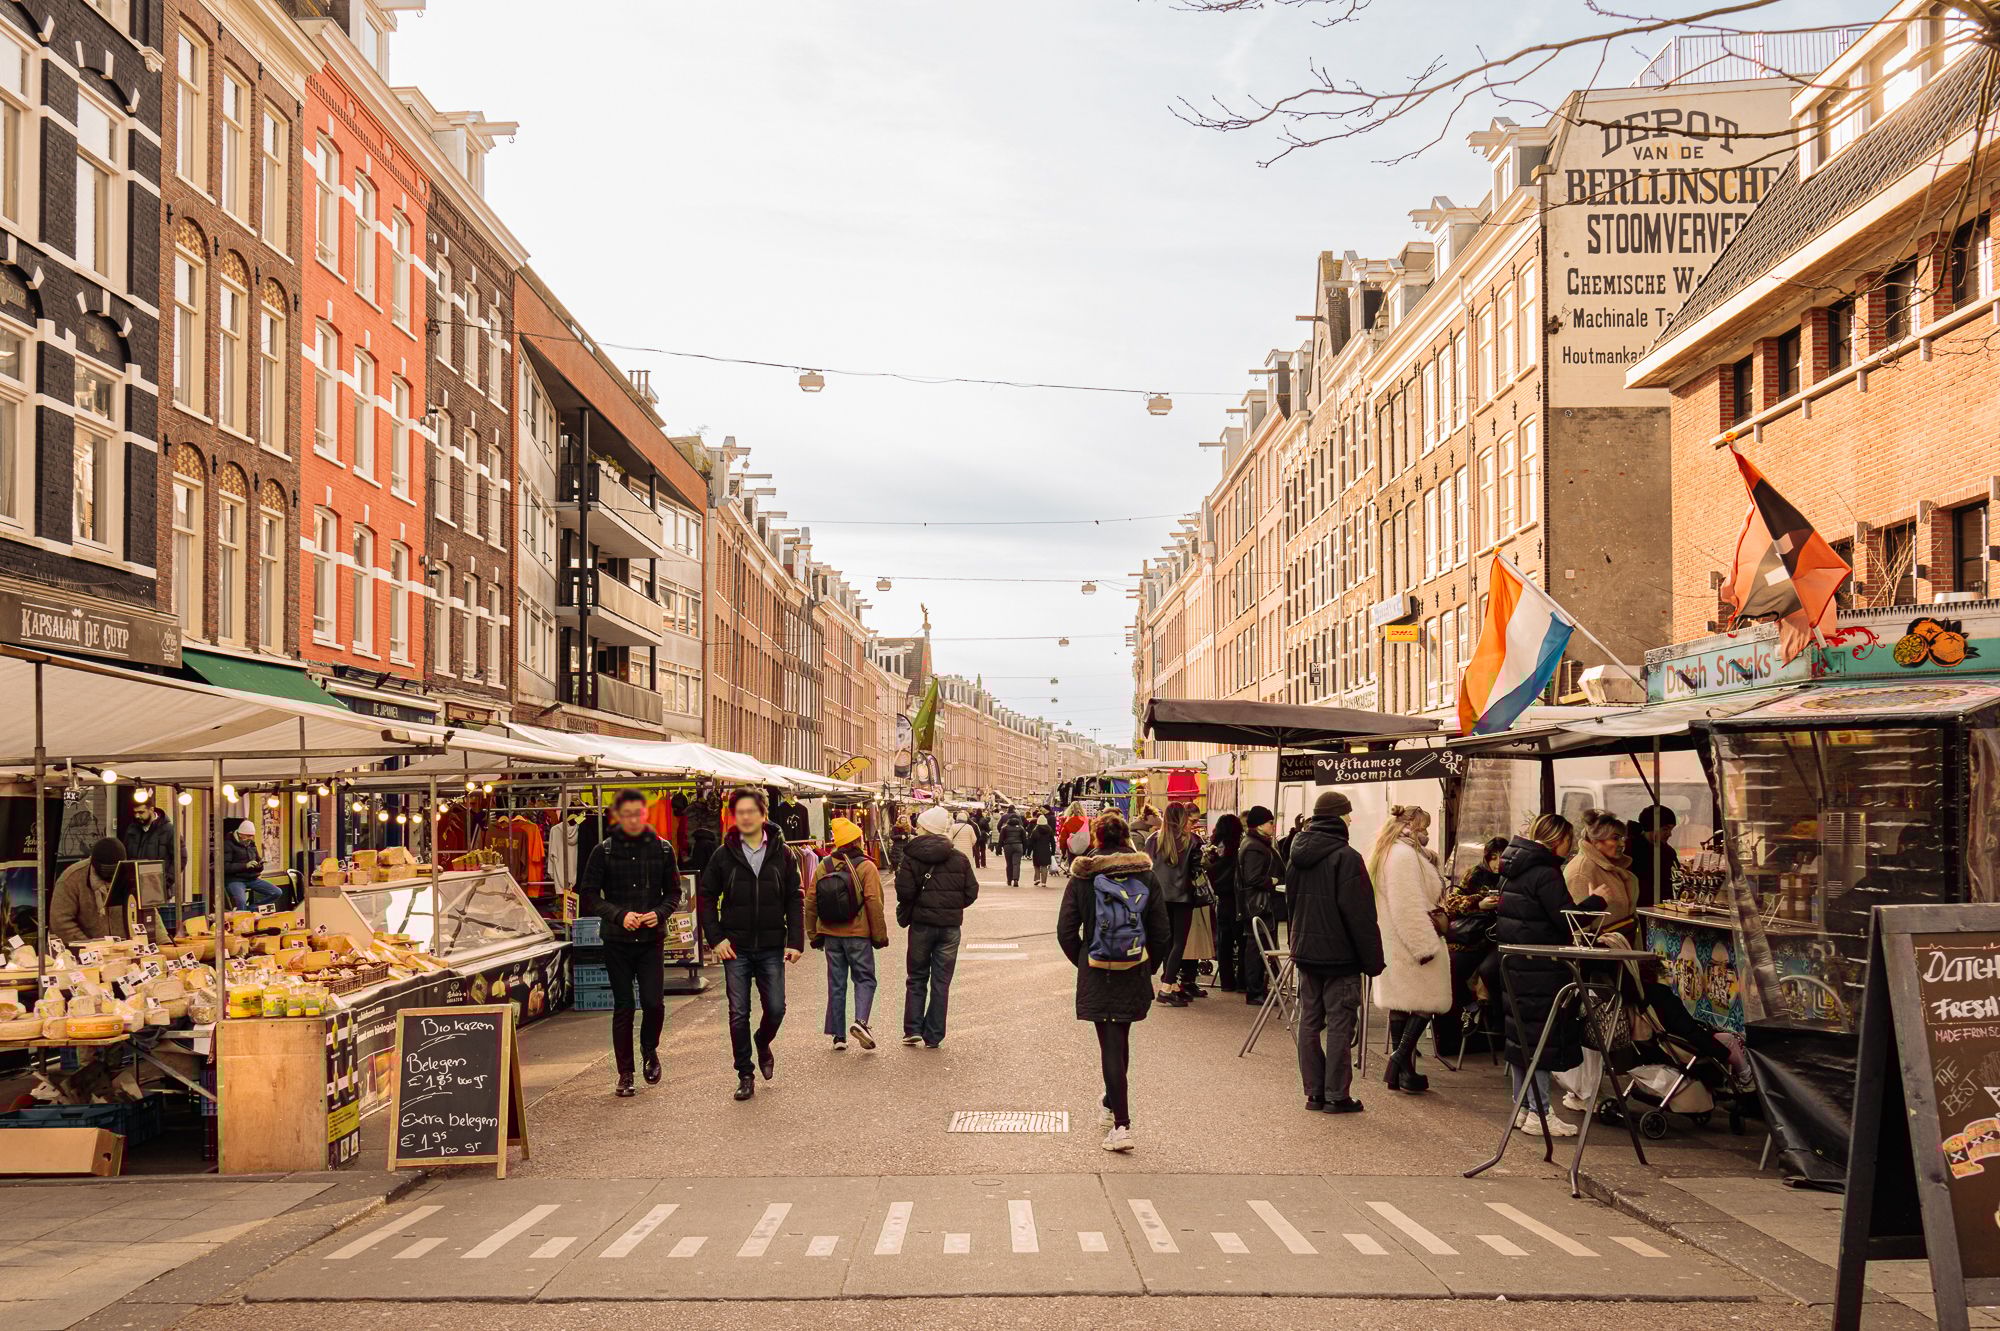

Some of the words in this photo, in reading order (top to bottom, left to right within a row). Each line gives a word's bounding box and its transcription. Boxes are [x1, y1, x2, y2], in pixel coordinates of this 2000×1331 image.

[1601, 108, 1739, 158] DEPOT
[1633, 146, 1668, 160] VAN
[1680, 146, 1704, 160] DE
[1587, 213, 1747, 254] STOOMVERVE
[1567, 268, 1666, 295] CHEMISCHE
[1673, 267, 1702, 294] W
[1573, 308, 1648, 328] Machinale
[21, 608, 80, 642] KAPSALON
[84, 620, 100, 647] DE
[103, 624, 129, 650] CUYP
[1317, 757, 1402, 771] Vietnamese
[1335, 769, 1402, 782] Loempia
[1930, 995, 1999, 1020] FRESH
[1935, 1029, 1961, 1043] MADE
[1962, 1027, 1988, 1039] FROM
[406, 1053, 467, 1075] Belegen
[1935, 1062, 1958, 1086] THE
[1941, 1069, 1978, 1117] BEST
[401, 1113, 445, 1127] Extra
